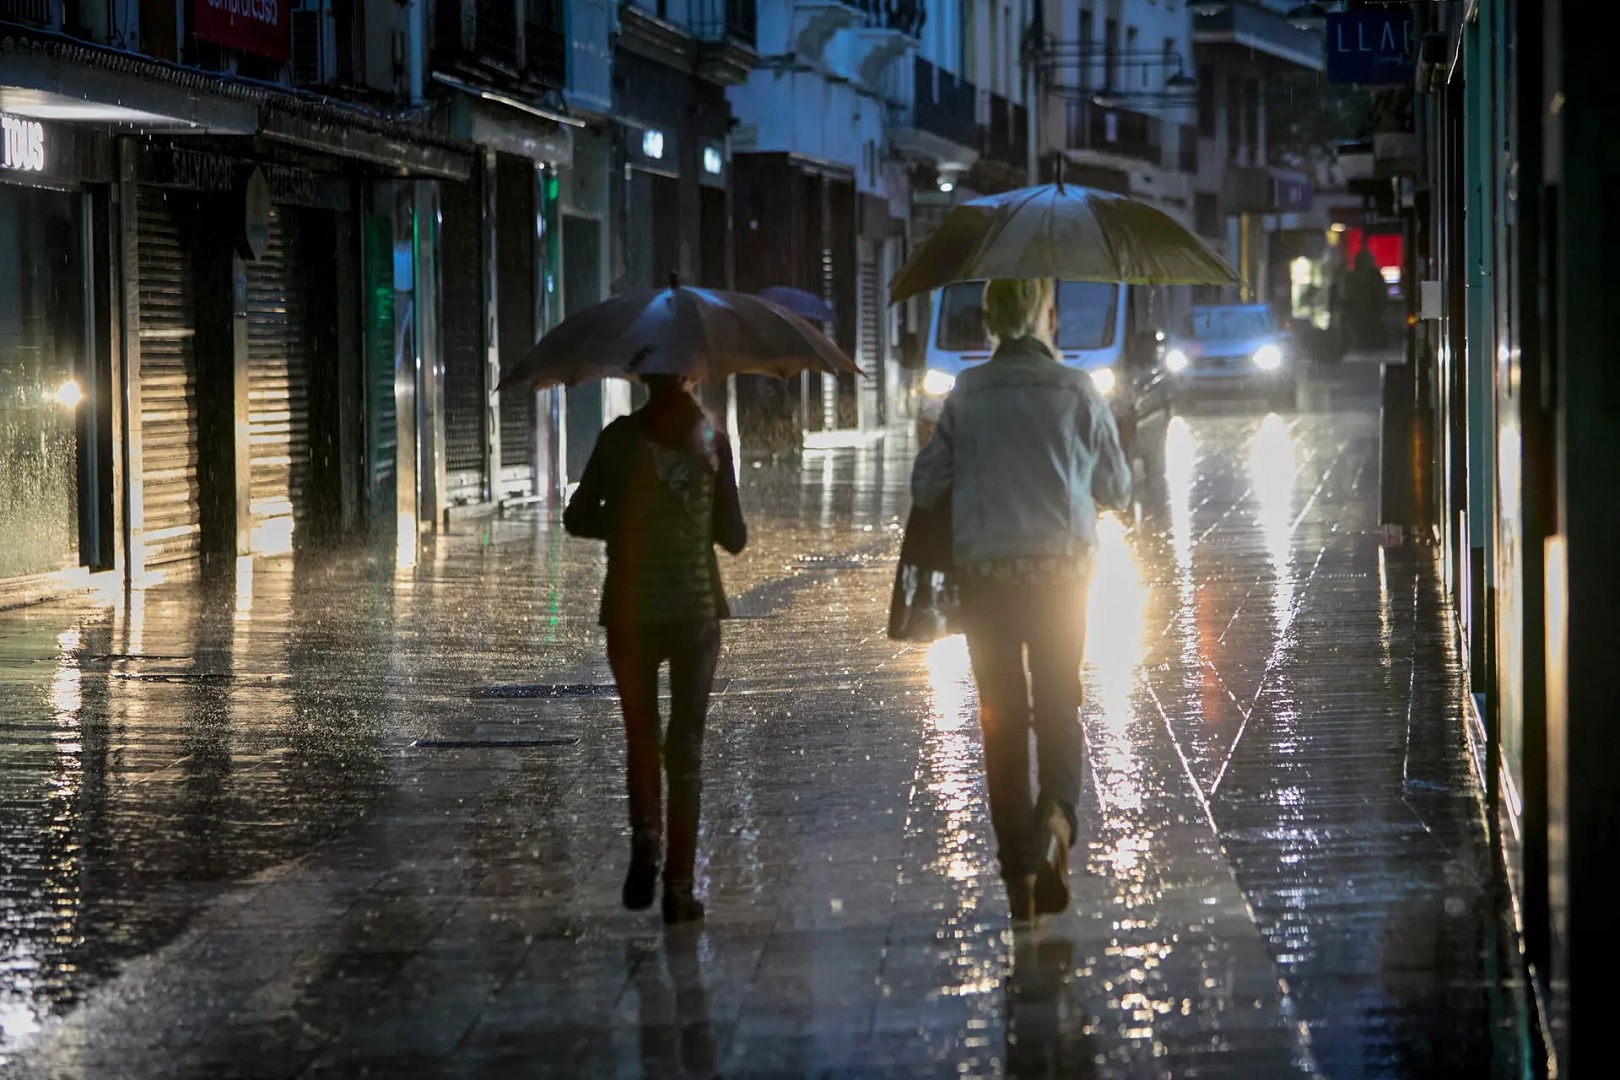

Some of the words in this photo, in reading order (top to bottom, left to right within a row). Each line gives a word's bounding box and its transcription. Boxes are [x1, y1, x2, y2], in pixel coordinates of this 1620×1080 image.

[207, 0, 278, 26] prarcasa
[1, 115, 44, 172] TOUS
[172, 150, 233, 191] SALVADOR
